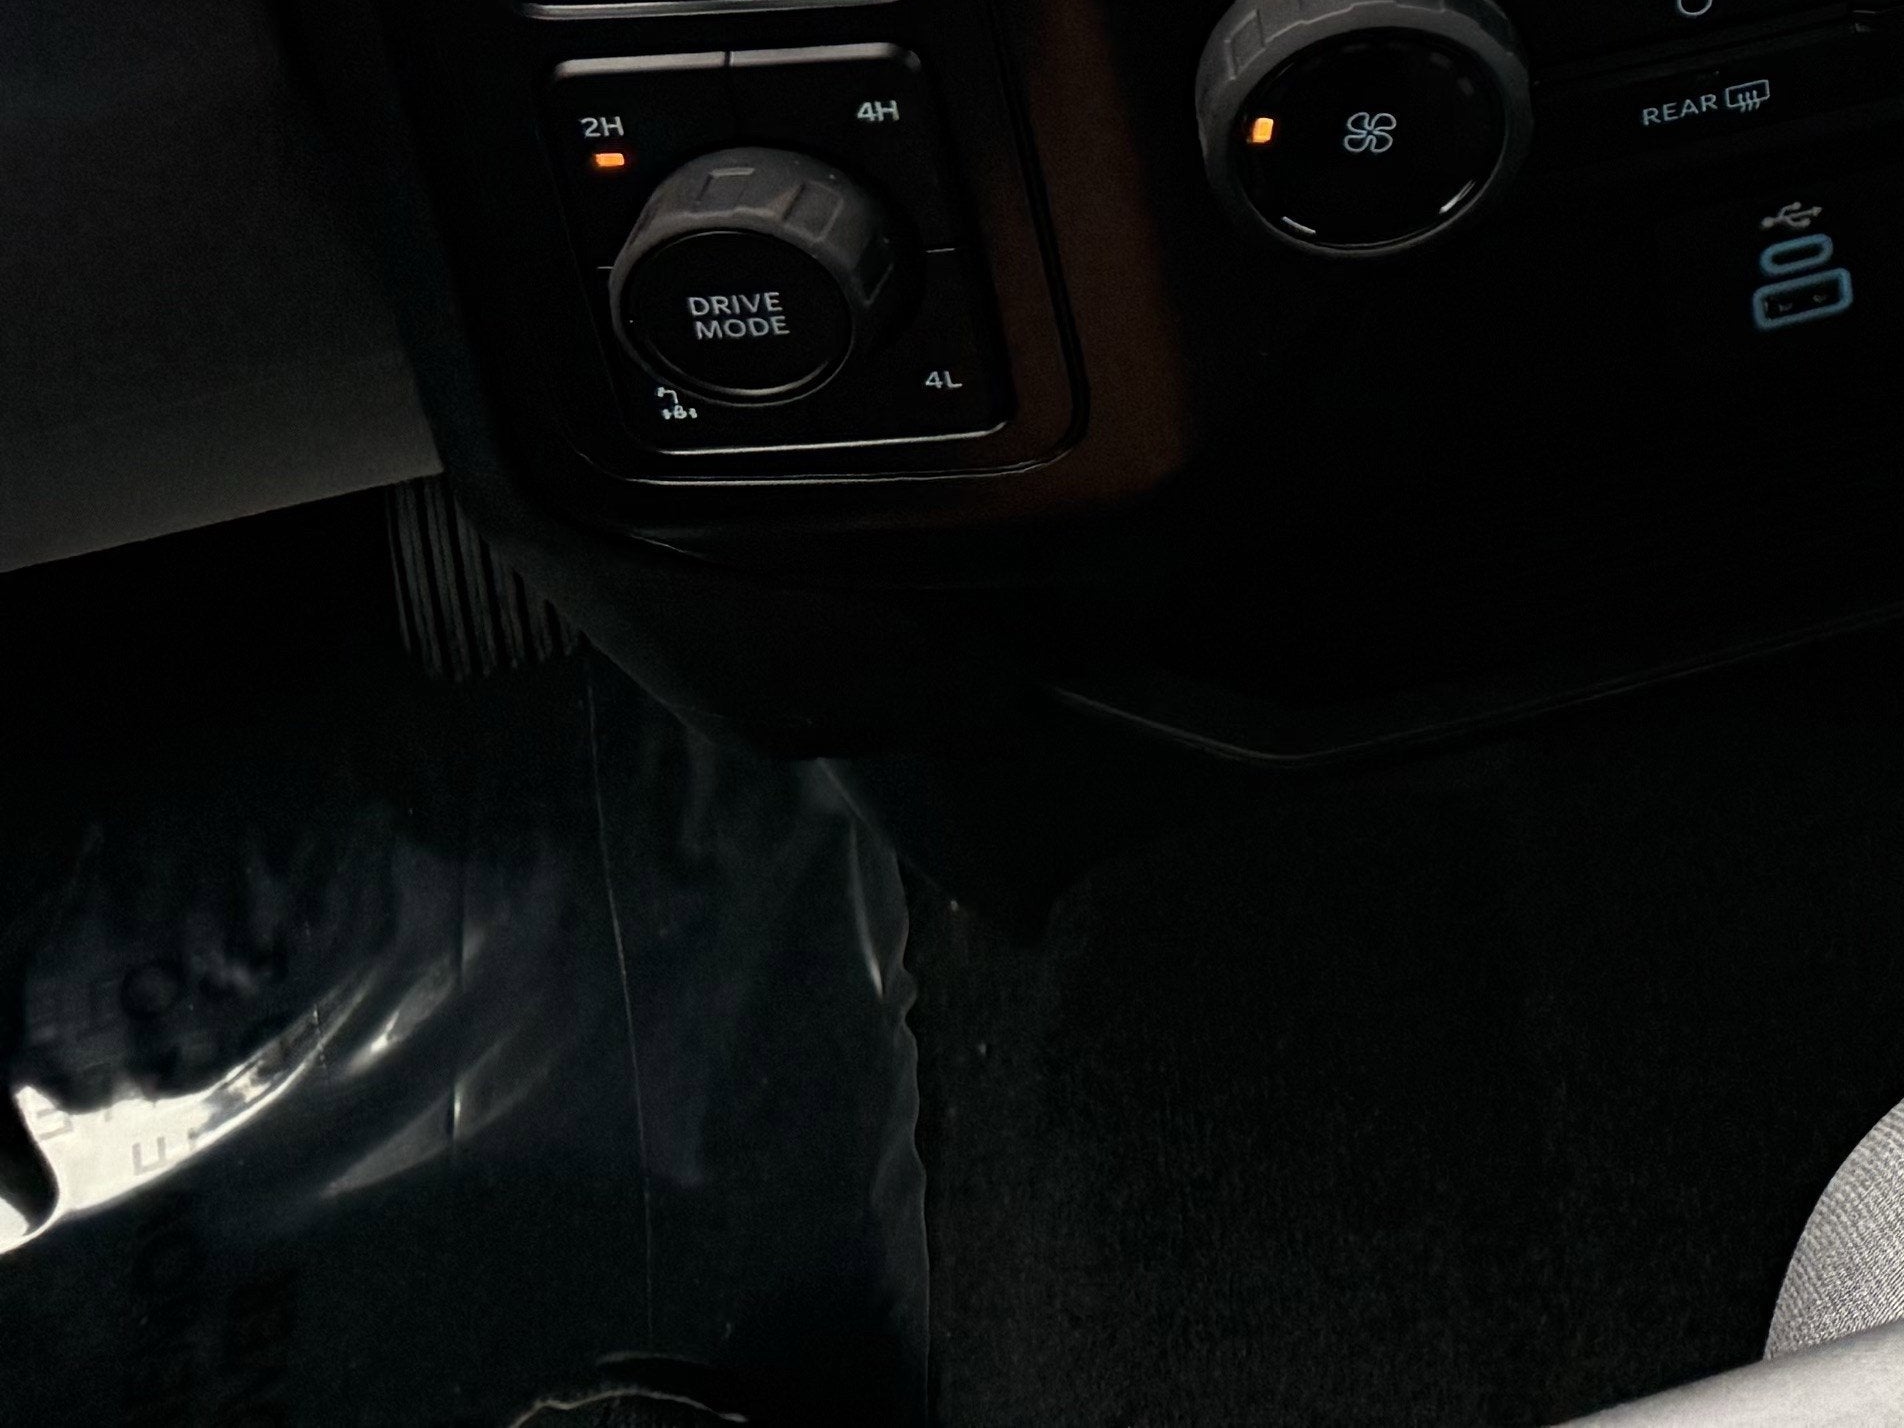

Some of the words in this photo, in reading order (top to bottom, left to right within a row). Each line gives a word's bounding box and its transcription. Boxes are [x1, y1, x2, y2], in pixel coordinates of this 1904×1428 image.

[856, 98, 901, 124] 4H
[1642, 93, 1719, 127] REAR
[579, 114, 625, 139] 2H
[687, 290, 784, 317] DRIVE
[693, 315, 791, 341] MODE
[923, 369, 964, 391] 4L
